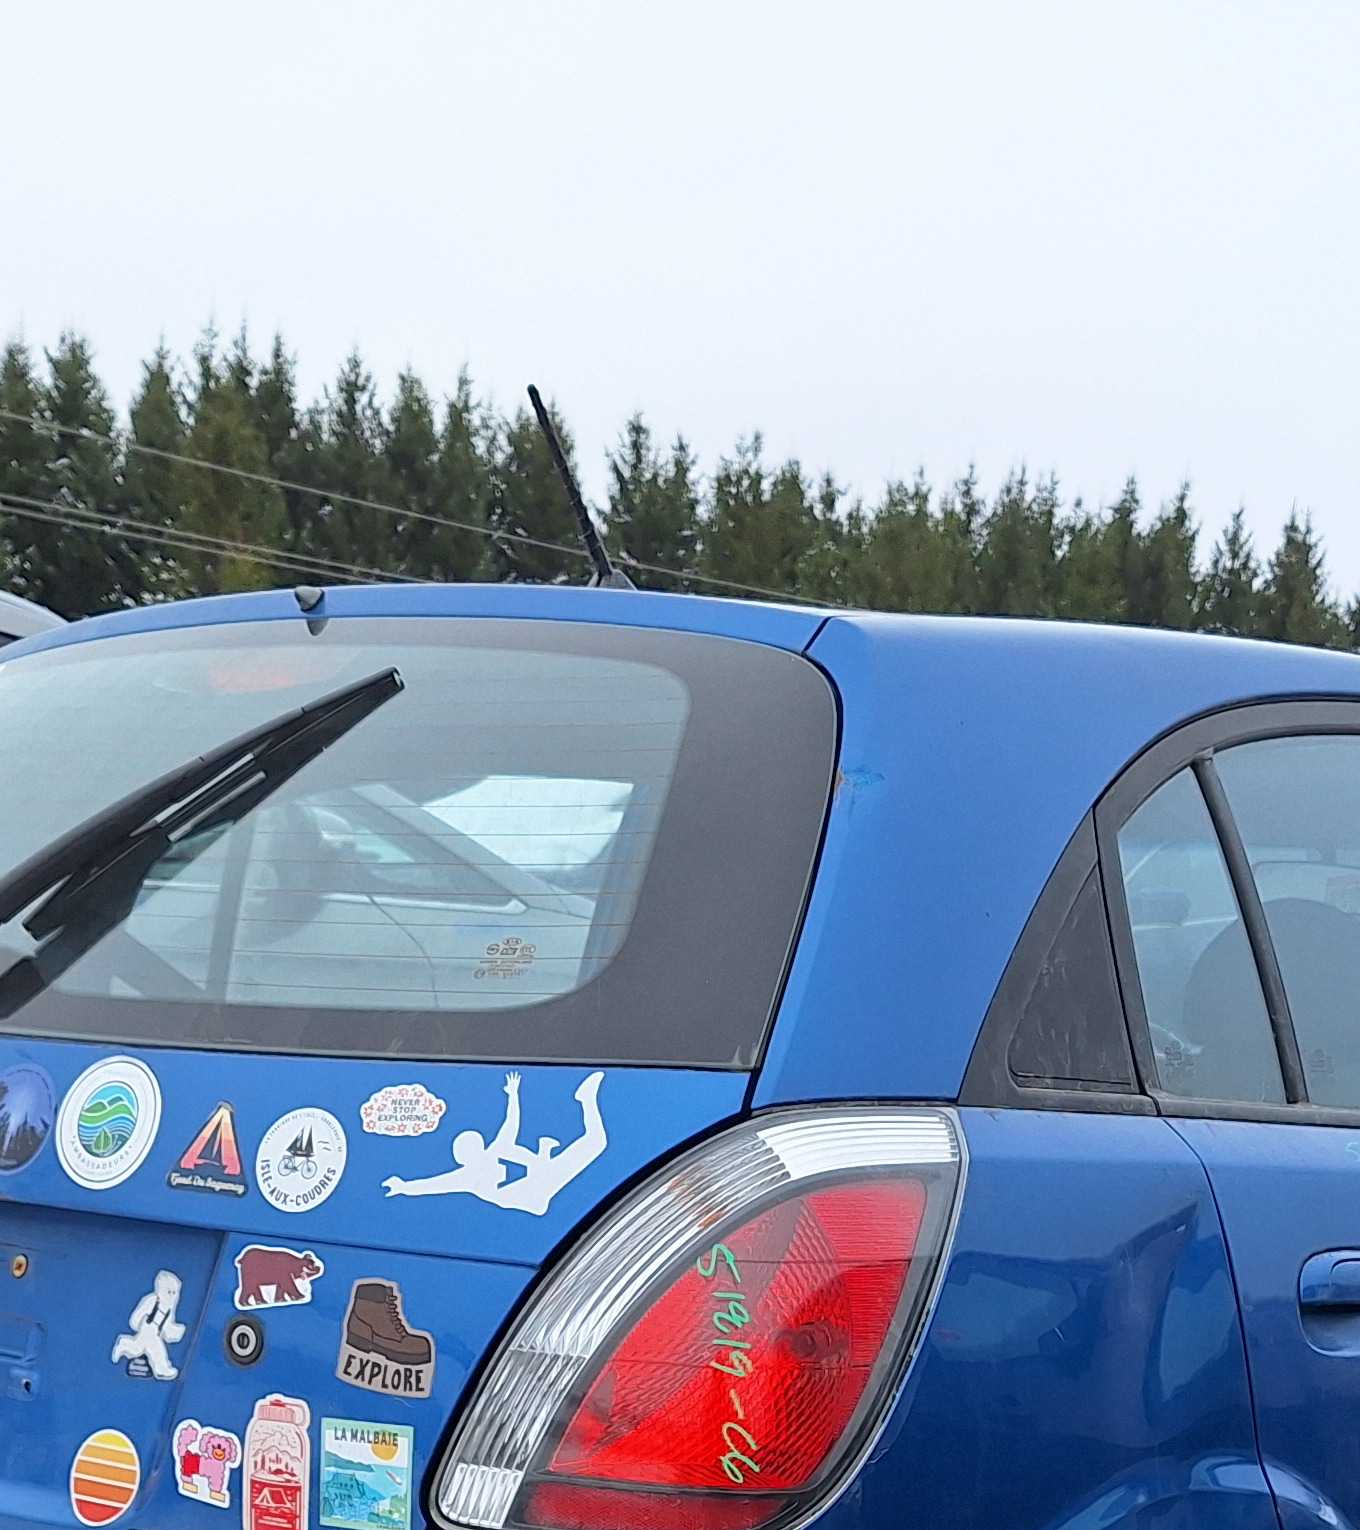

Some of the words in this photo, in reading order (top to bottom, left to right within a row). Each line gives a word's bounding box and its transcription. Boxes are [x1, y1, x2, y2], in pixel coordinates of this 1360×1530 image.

[390, 1098, 420, 1106] NEVER
[392, 1106, 417, 1114] STOP
[377, 1114, 428, 1122] EXPLORING
[260, 1159, 337, 1206] ISLE-AUX-COUDRES
[343, 1354, 425, 1392] EXPLORE
[334, 1426, 348, 1441] LA
[350, 1427, 399, 1448] MALBAIE
